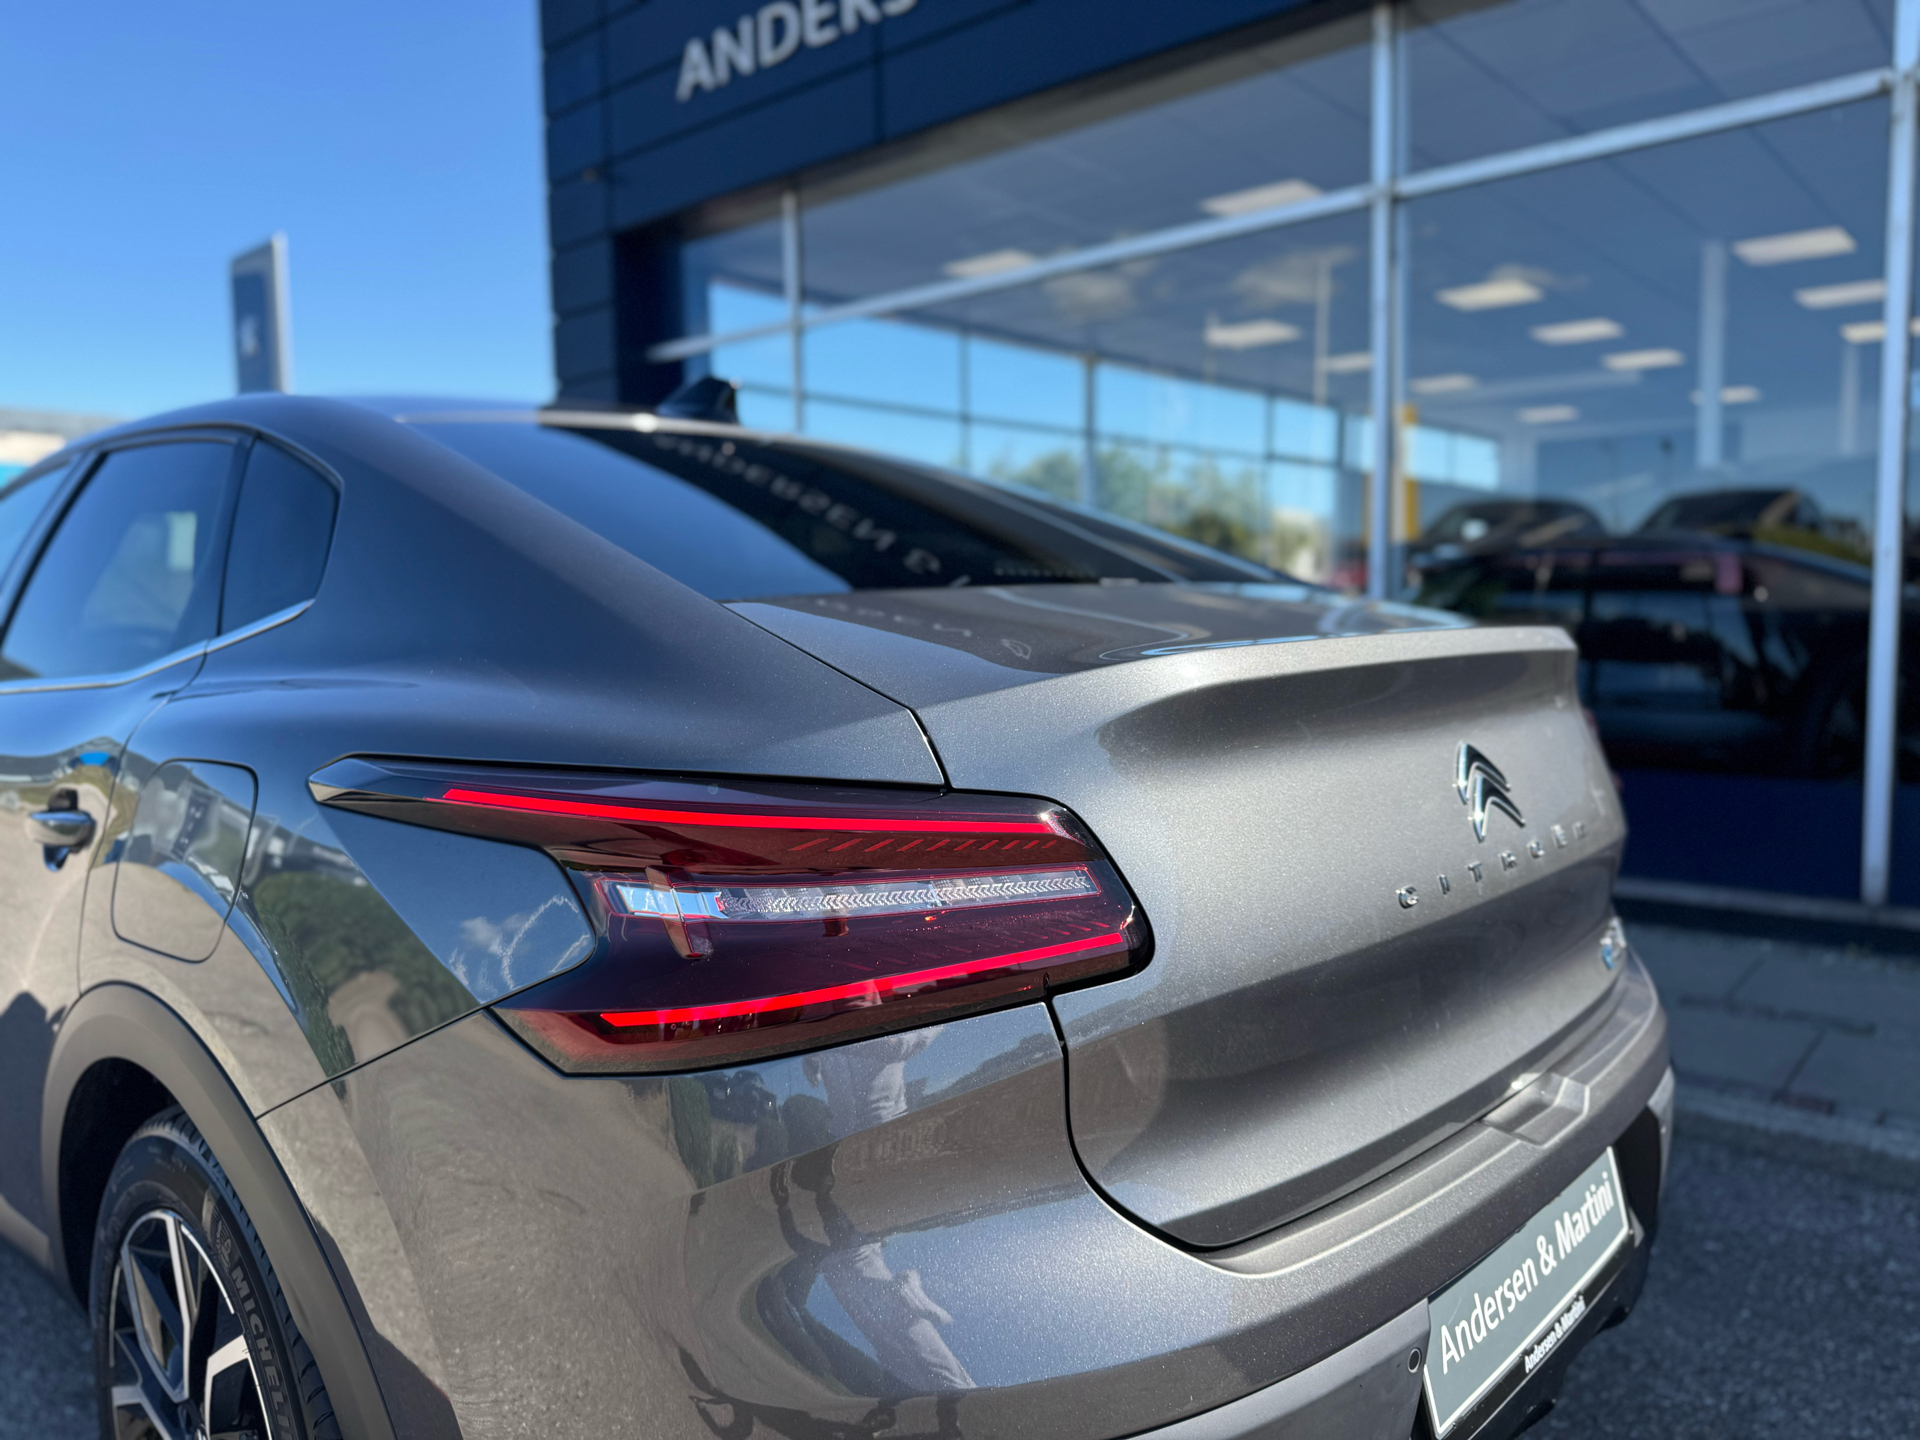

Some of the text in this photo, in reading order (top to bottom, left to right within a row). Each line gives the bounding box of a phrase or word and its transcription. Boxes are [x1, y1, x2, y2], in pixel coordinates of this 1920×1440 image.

[1440, 1170, 1615, 1375] Andersen & Martini
[1524, 1294, 1587, 1374] Andersen & Martini
